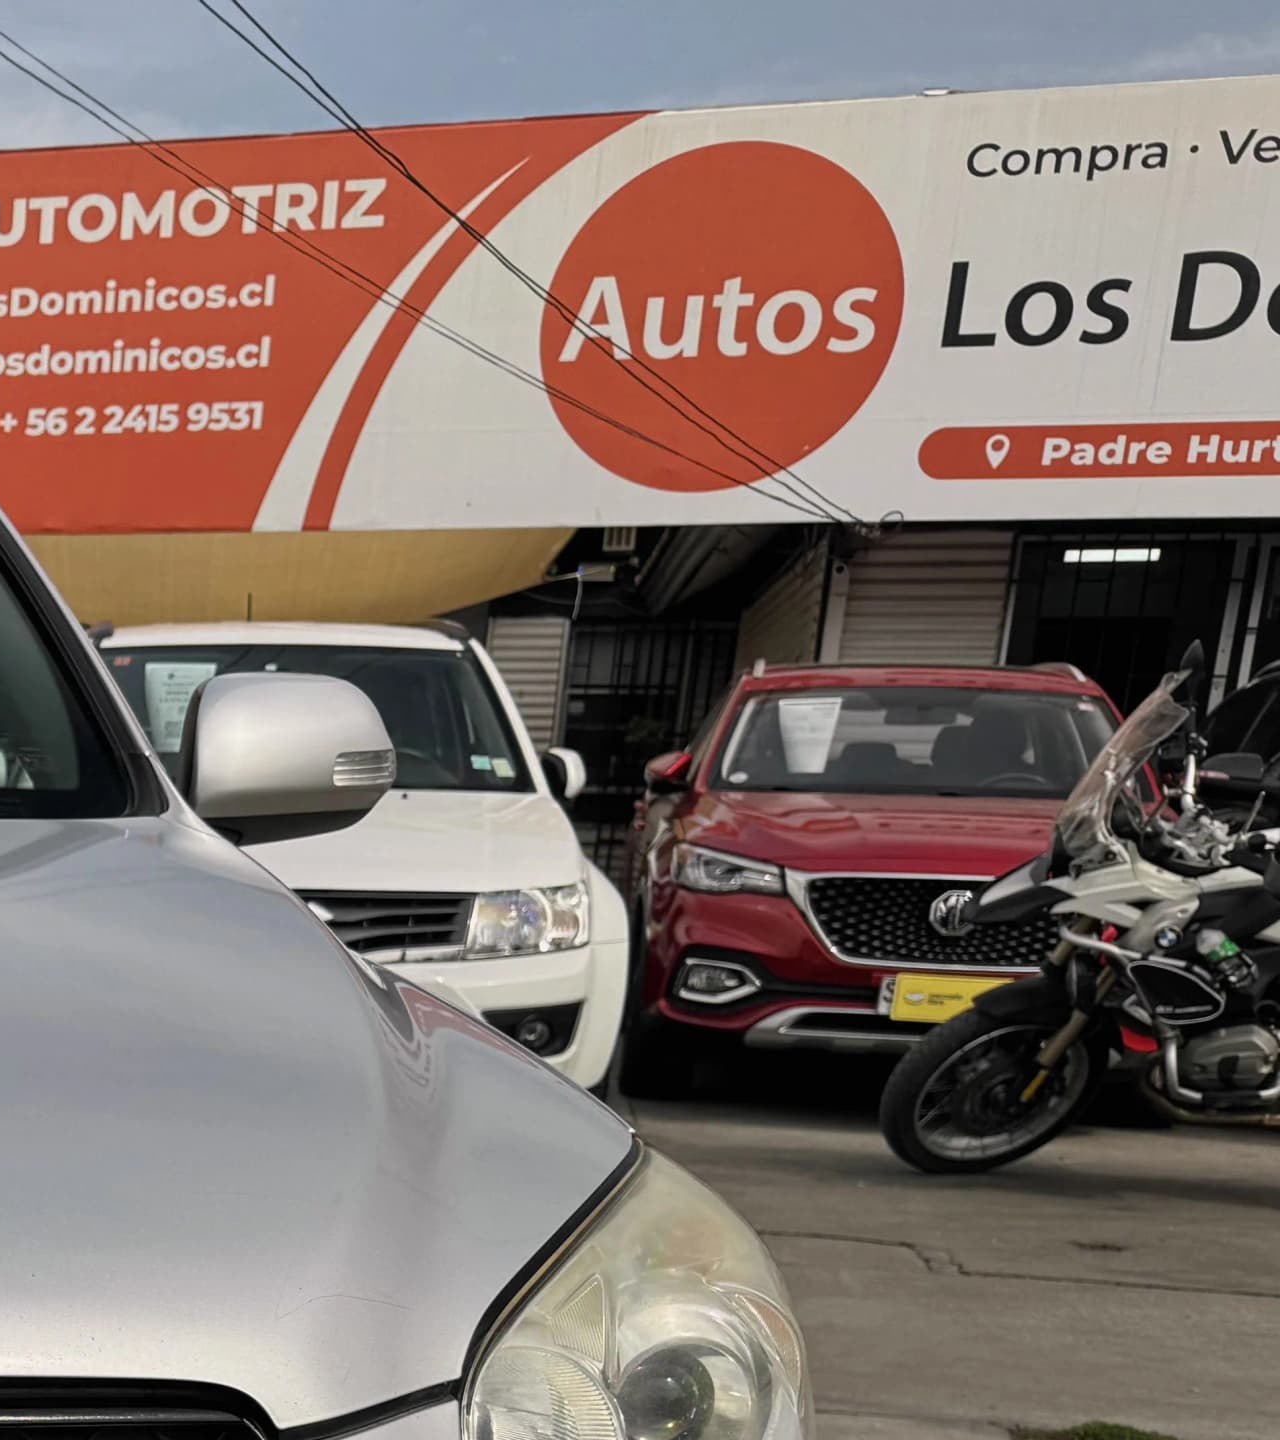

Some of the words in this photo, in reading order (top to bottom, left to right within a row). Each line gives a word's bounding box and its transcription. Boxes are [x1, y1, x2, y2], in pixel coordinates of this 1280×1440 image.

[966, 142, 1168, 181] Compra
[1219, 129, 1280, 164] Ve
[558, 275, 878, 362] Autos
[941, 261, 1132, 348] Los
[1171, 251, 1280, 342] D
[24, 407, 68, 437] 56
[73, 406, 97, 435] 2
[102, 403, 180, 434] 2415
[186, 400, 264, 432] 9531
[1041, 435, 1172, 466] Padre
